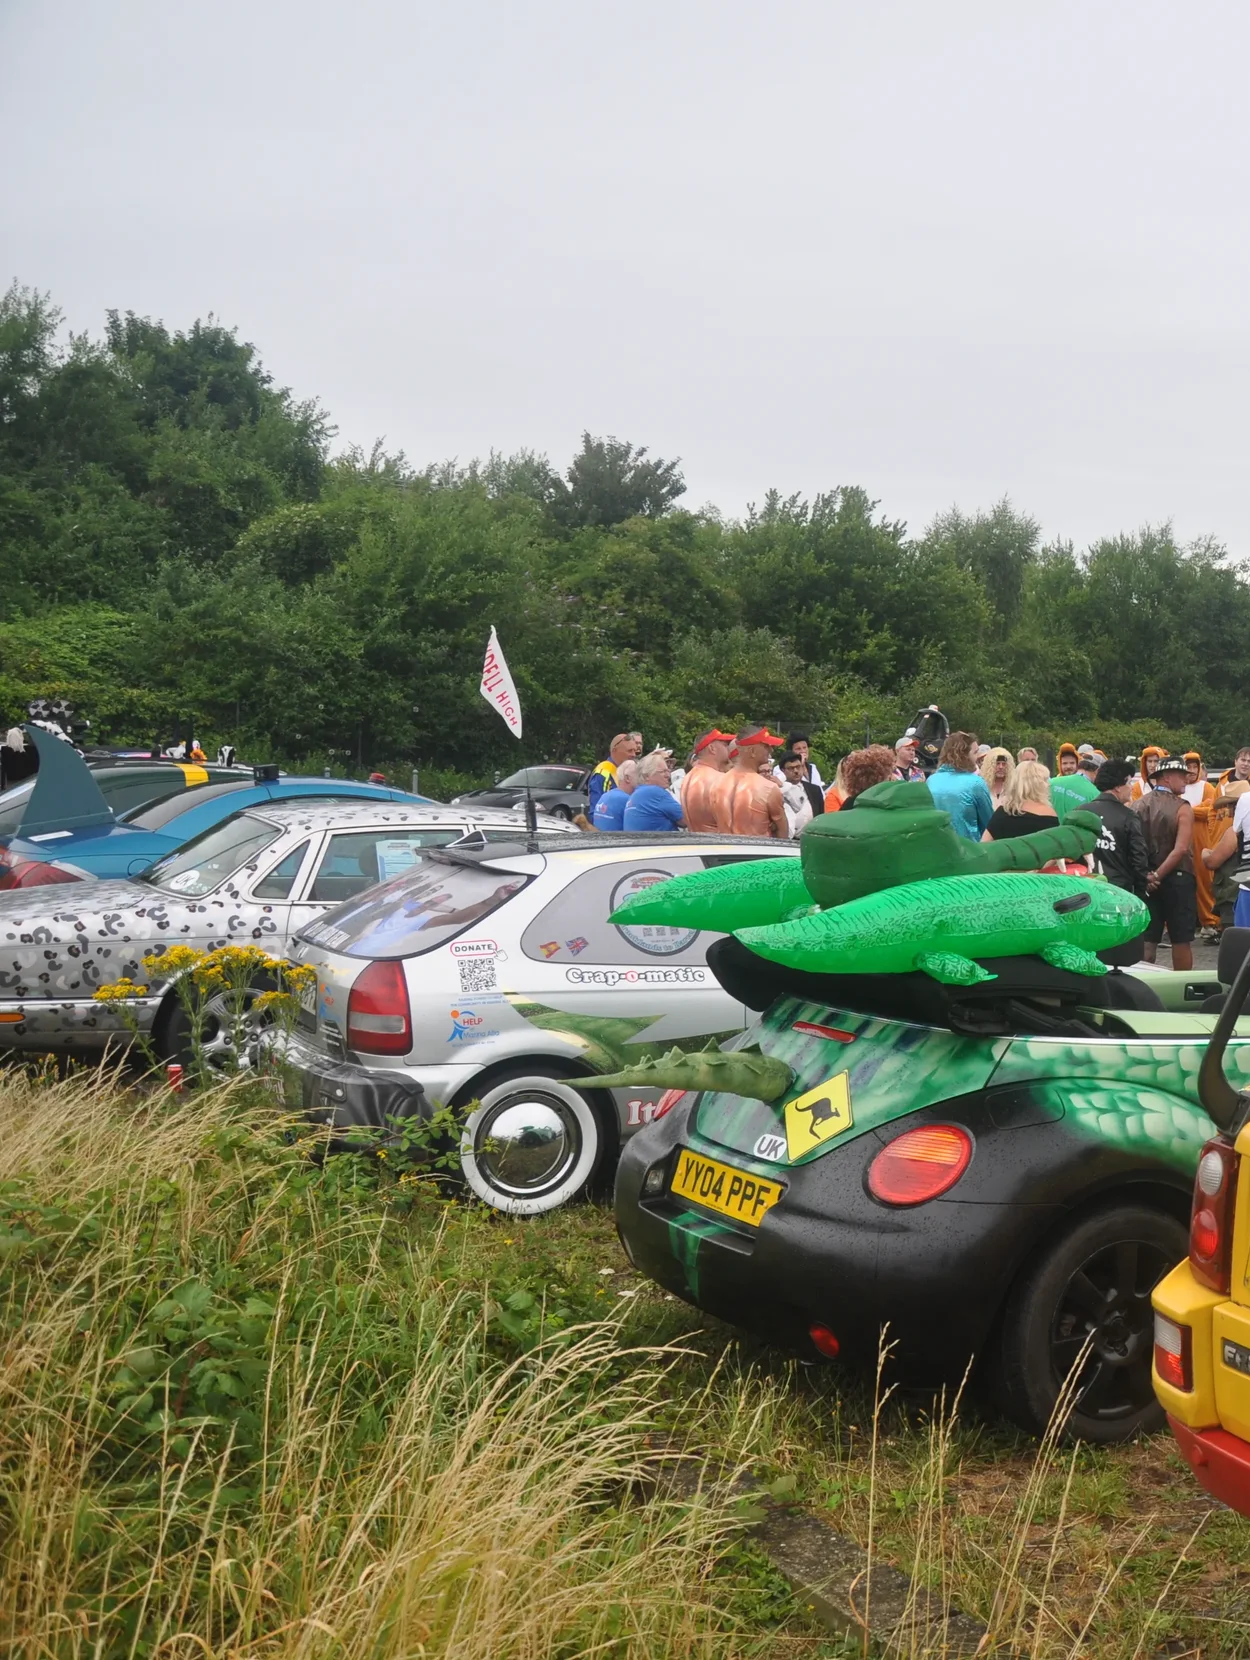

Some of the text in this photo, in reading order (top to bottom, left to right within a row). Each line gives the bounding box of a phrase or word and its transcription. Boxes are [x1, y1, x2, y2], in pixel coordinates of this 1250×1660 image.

[495, 690, 518, 726] HIGH
[454, 943, 494, 953] DONATE
[565, 967, 706, 987] Crap-o-matic
[462, 1017, 484, 1026] HELP
[757, 1136, 785, 1159] UK
[681, 1157, 772, 1217] YY04 PPF
